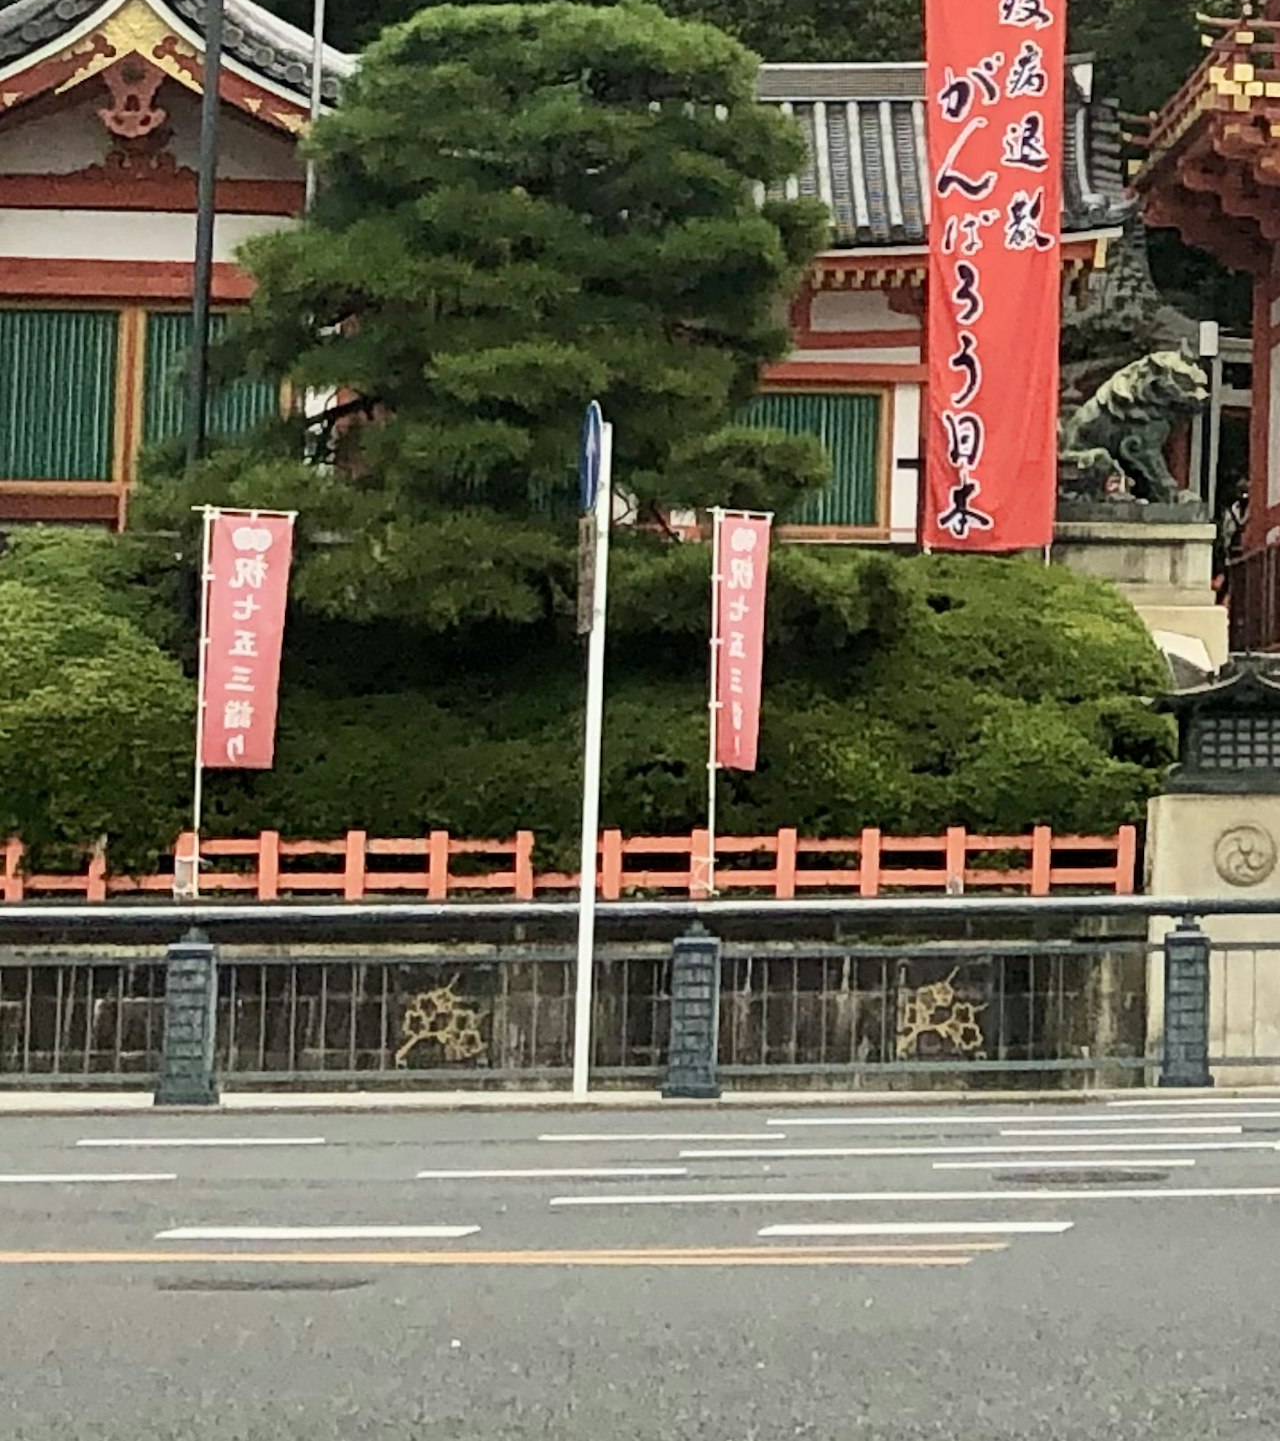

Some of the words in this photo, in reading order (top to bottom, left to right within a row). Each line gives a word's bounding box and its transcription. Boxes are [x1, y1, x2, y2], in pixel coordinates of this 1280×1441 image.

[937, 51, 1004, 537] がんばろう日本
